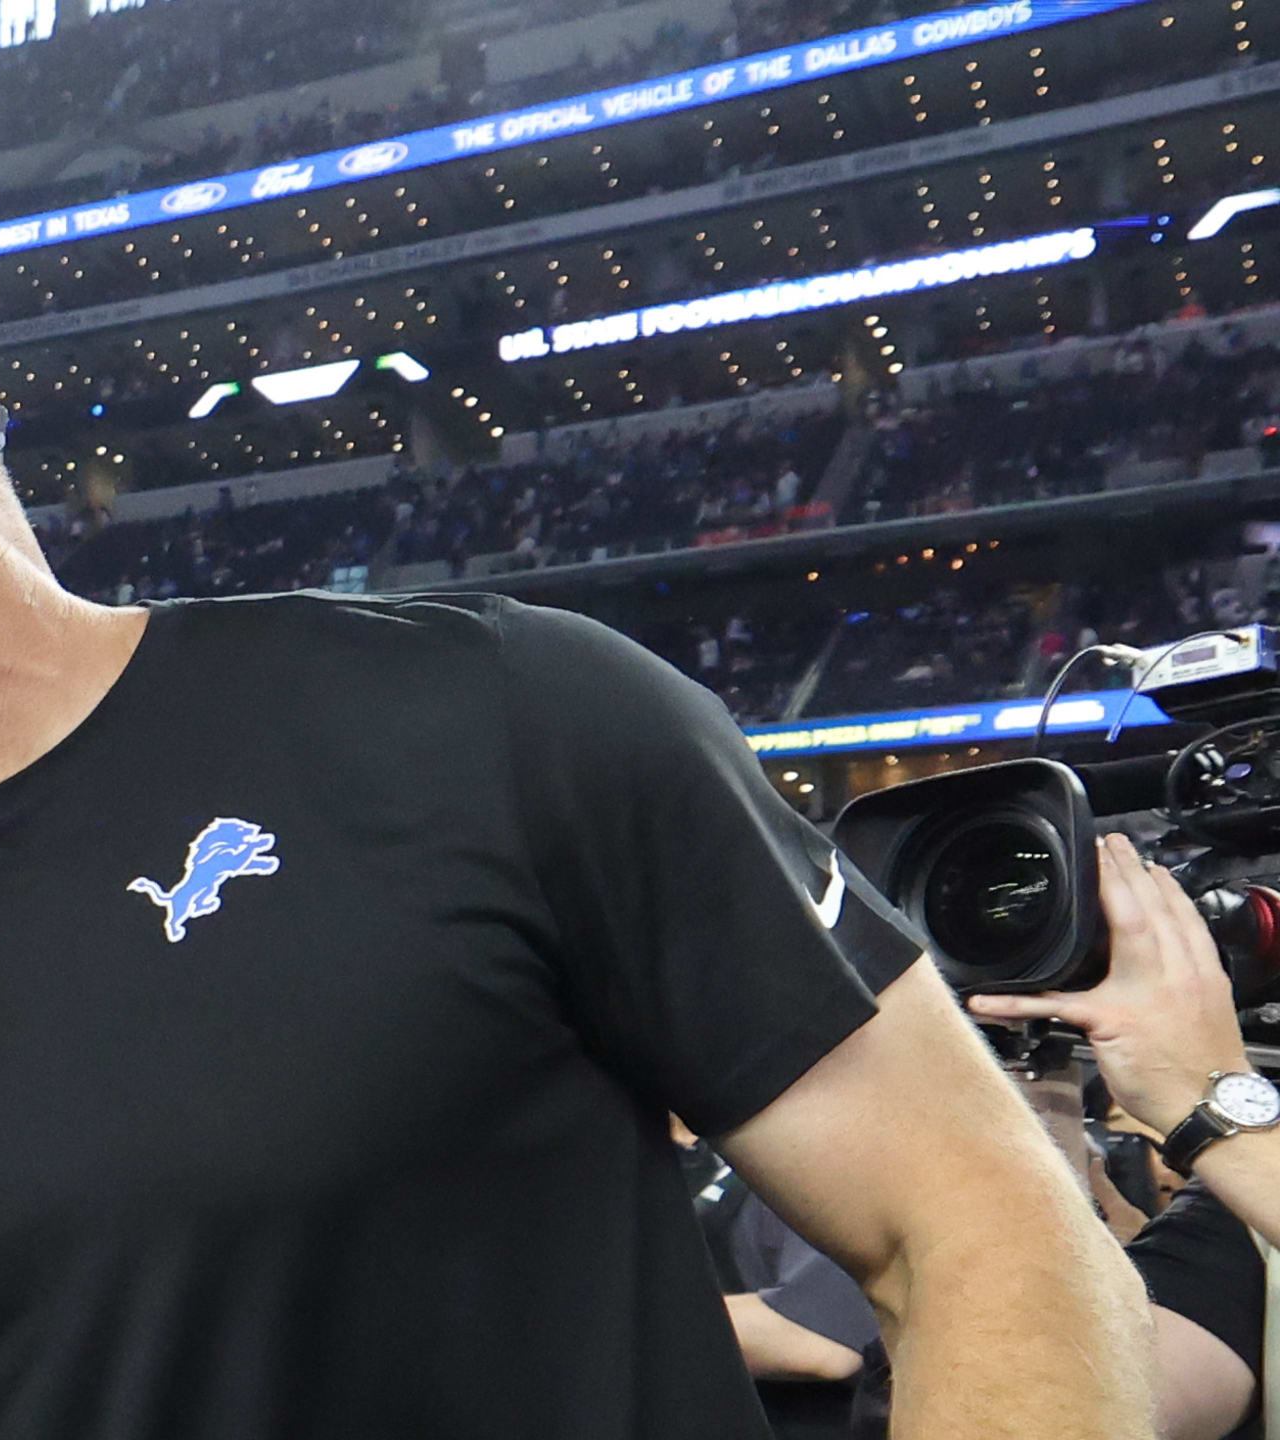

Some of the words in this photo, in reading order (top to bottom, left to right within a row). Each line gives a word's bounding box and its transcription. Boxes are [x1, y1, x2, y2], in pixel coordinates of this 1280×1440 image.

[453, 123, 496, 149] THE
[500, 103, 594, 141] OFFICIAL
[601, 78, 694, 119] VEHICLE
[702, 67, 736, 95] OF
[744, 54, 792, 84] THE
[804, 31, 897, 71] DALLAS
[912, 0, 1033, 47] COWBOYS
[250, 163, 314, 199] Ford
[46, 215, 67, 238] IN
[72, 203, 130, 232] TEXAS
